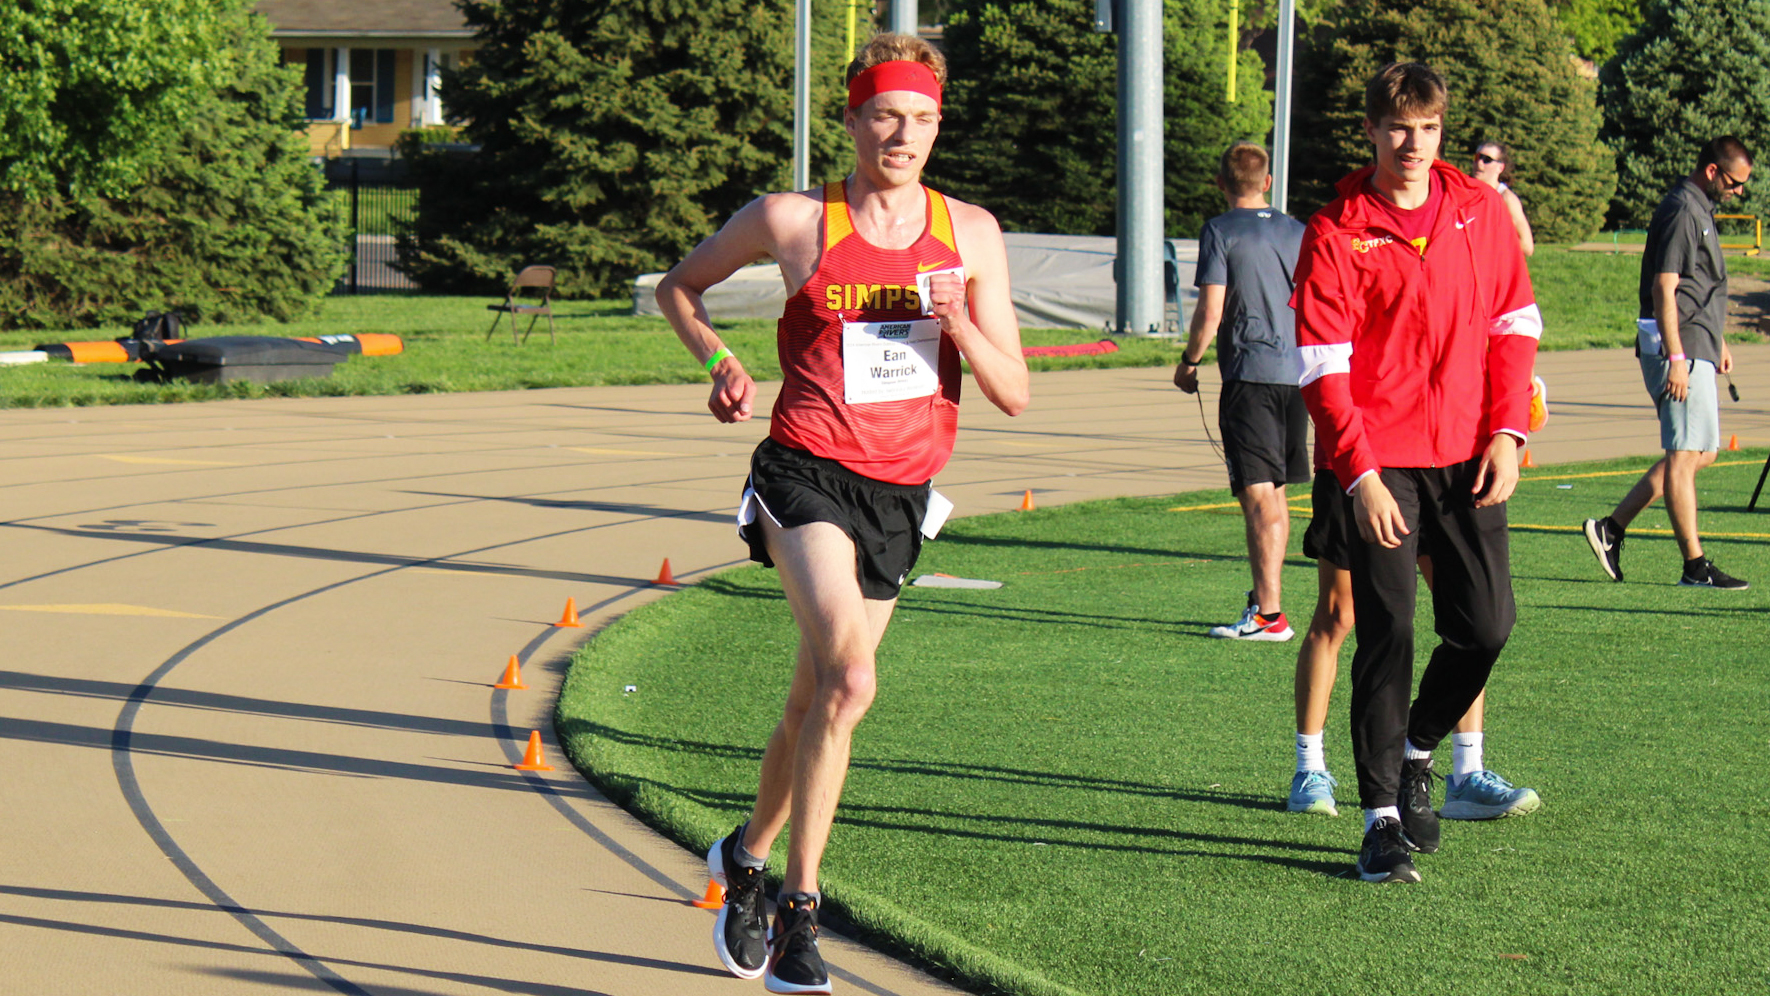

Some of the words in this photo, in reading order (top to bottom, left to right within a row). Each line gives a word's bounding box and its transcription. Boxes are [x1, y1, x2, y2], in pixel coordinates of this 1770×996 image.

[825, 284, 921, 310] SIMPS
[883, 350, 906, 361] Ean
[870, 365, 917, 379] Warrick
